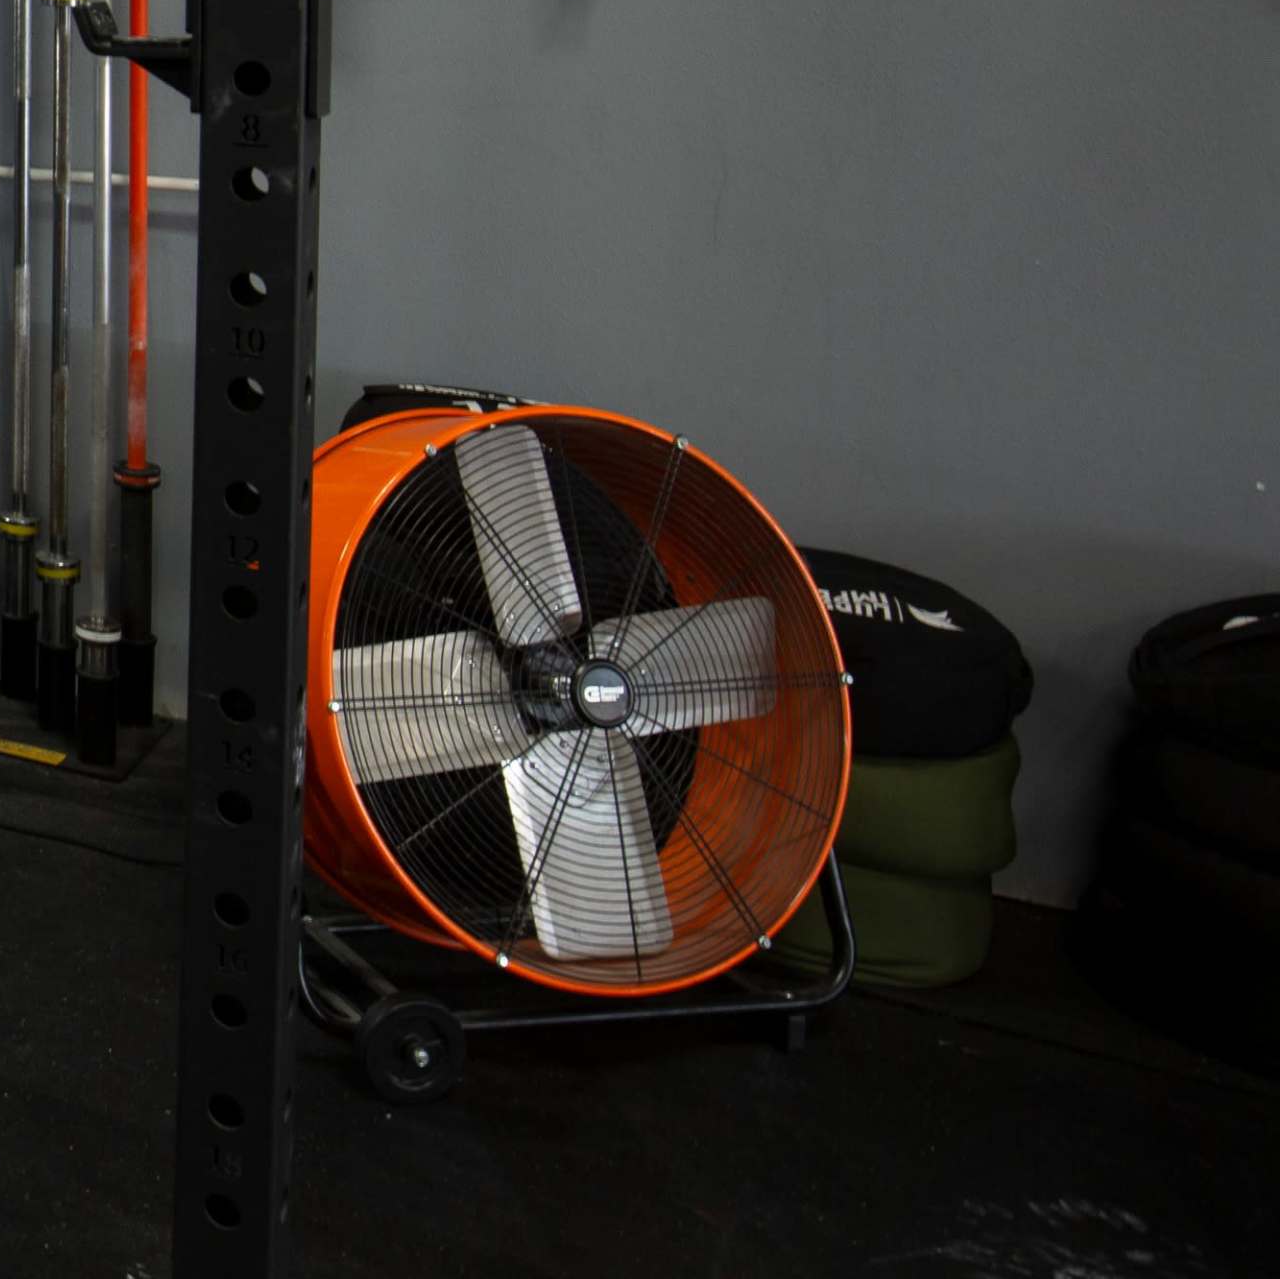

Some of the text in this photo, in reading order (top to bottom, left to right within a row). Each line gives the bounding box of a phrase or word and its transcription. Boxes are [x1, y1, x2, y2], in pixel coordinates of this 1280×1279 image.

[242, 114, 261, 142] 8
[231, 327, 265, 353] 10
[228, 535, 261, 562] 12
[221, 739, 253, 768] 14
